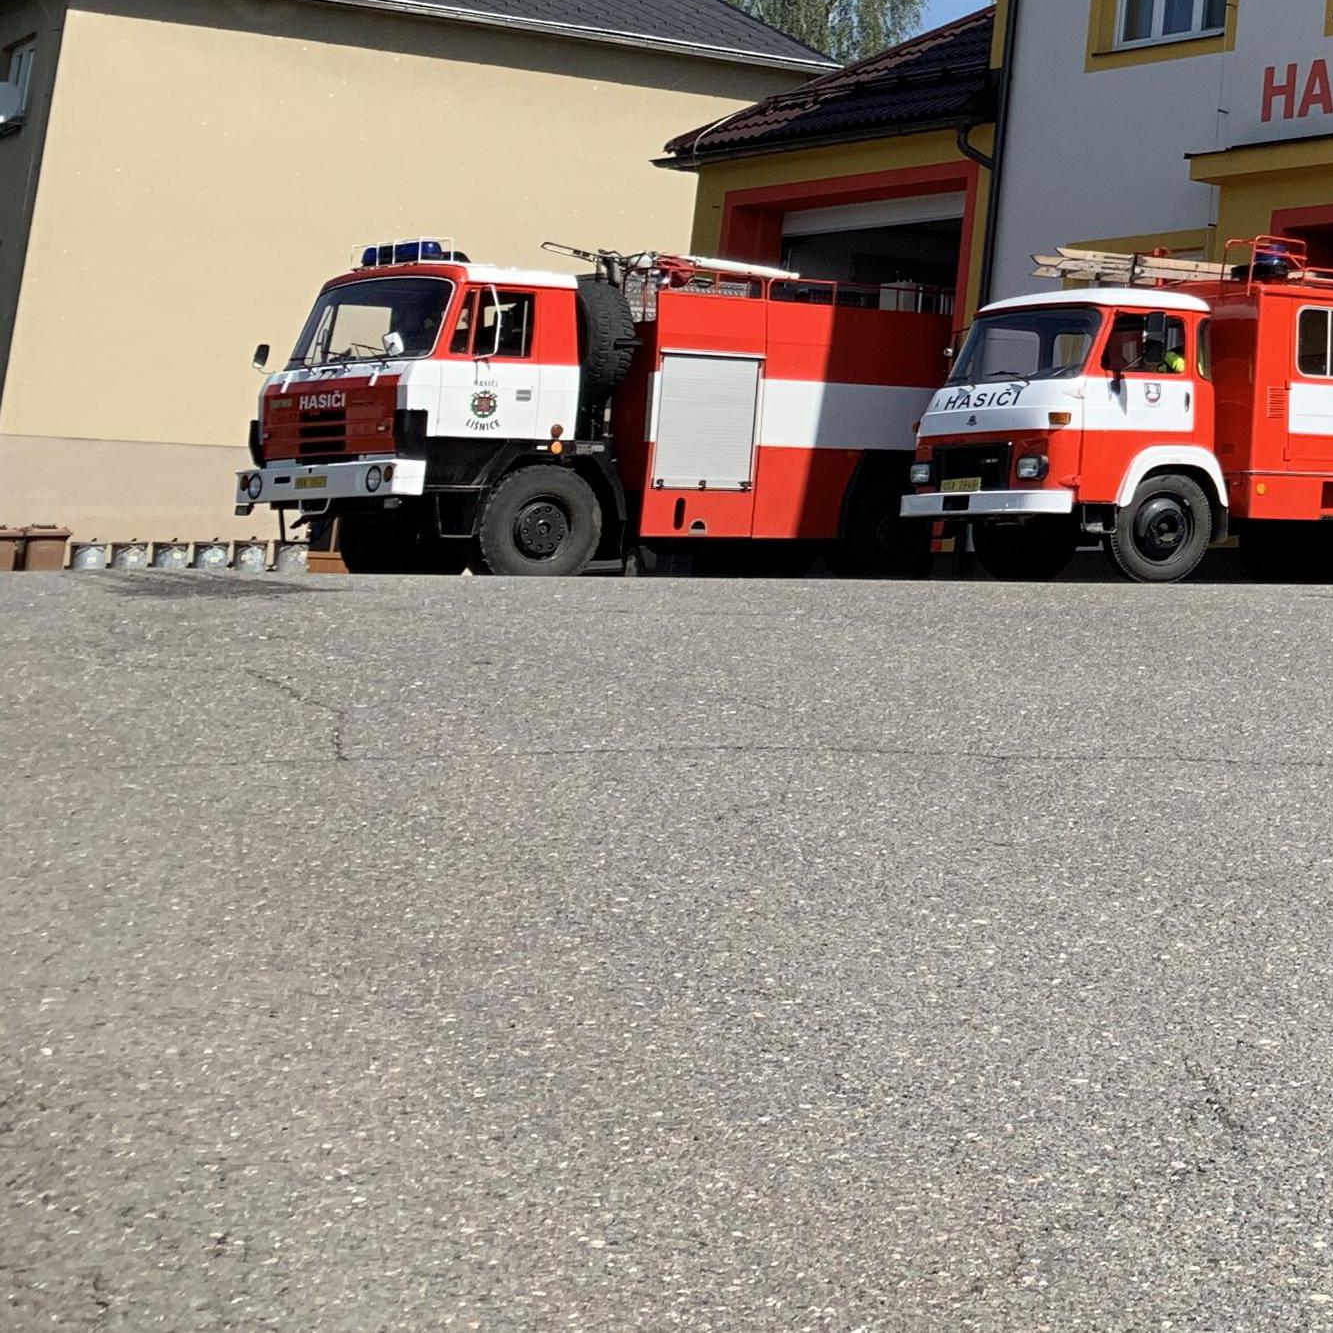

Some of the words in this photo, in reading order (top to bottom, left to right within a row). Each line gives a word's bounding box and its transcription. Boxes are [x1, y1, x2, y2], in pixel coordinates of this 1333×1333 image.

[299, 390, 346, 410] HASIČI
[944, 389, 1021, 411] HASIČI
[466, 418, 501, 432] LIŠNICE
